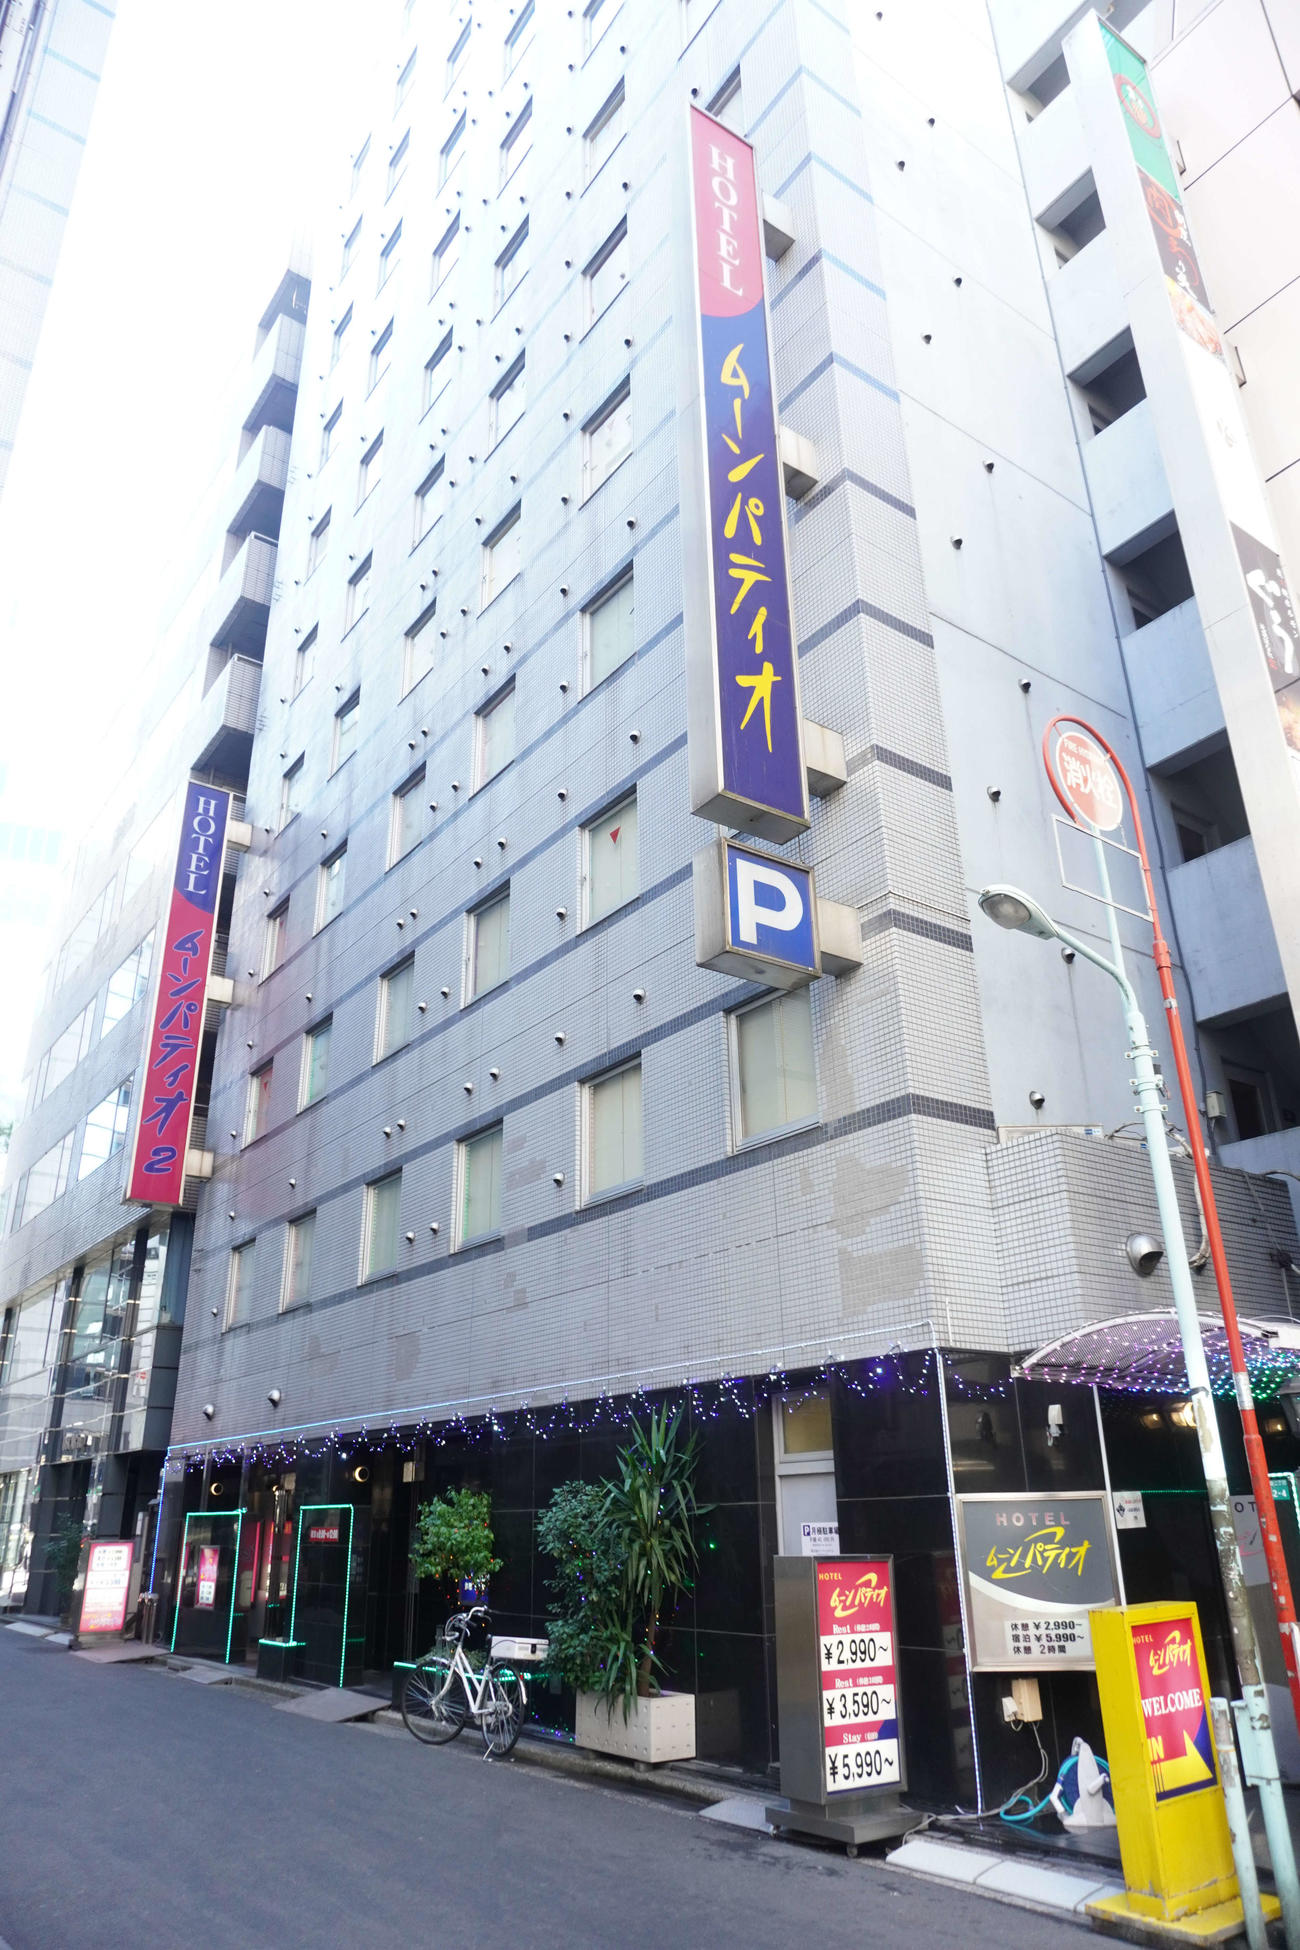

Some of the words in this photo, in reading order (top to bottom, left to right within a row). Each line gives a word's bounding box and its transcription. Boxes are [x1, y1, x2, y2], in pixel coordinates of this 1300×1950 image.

[709, 144, 744, 297] HOTEL
[720, 343, 783, 754] ムーンパティオ
[1061, 752, 1118, 809] 消火栓
[185, 795, 219, 895] HOTEL
[735, 858, 804, 945] P
[995, 1511, 1071, 1527] HOTEL
[986, 1533, 1092, 1578] ムーンパティオ
[818, 1572, 842, 1581] HOTEL
[830, 1579, 889, 1613] ムーンパティオ
[832, 1623, 851, 1634] Rest
[1012, 1633, 1031, 1643] 宿泊
[1149, 1634, 1192, 1672] ムーンパティオ
[835, 1677, 853, 1688] Rest
[1141, 1688, 1202, 1719] WELCOME
[842, 1732, 862, 1744] Stay
